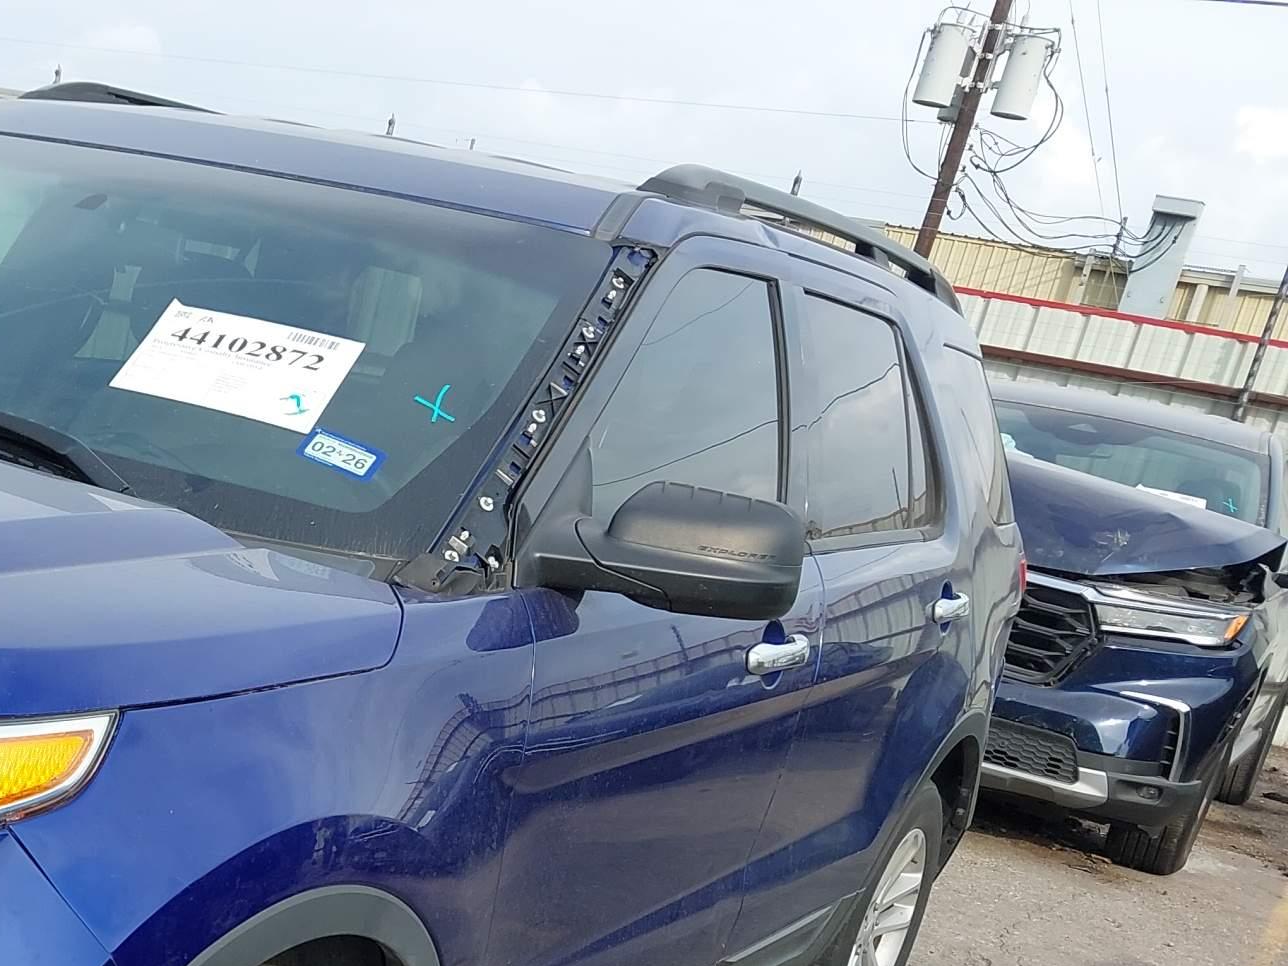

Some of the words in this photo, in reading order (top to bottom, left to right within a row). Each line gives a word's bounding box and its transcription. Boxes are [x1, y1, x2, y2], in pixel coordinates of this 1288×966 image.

[171, 327, 325, 371] 44102872
[311, 441, 337, 457] 02
[341, 453, 368, 470] 26
